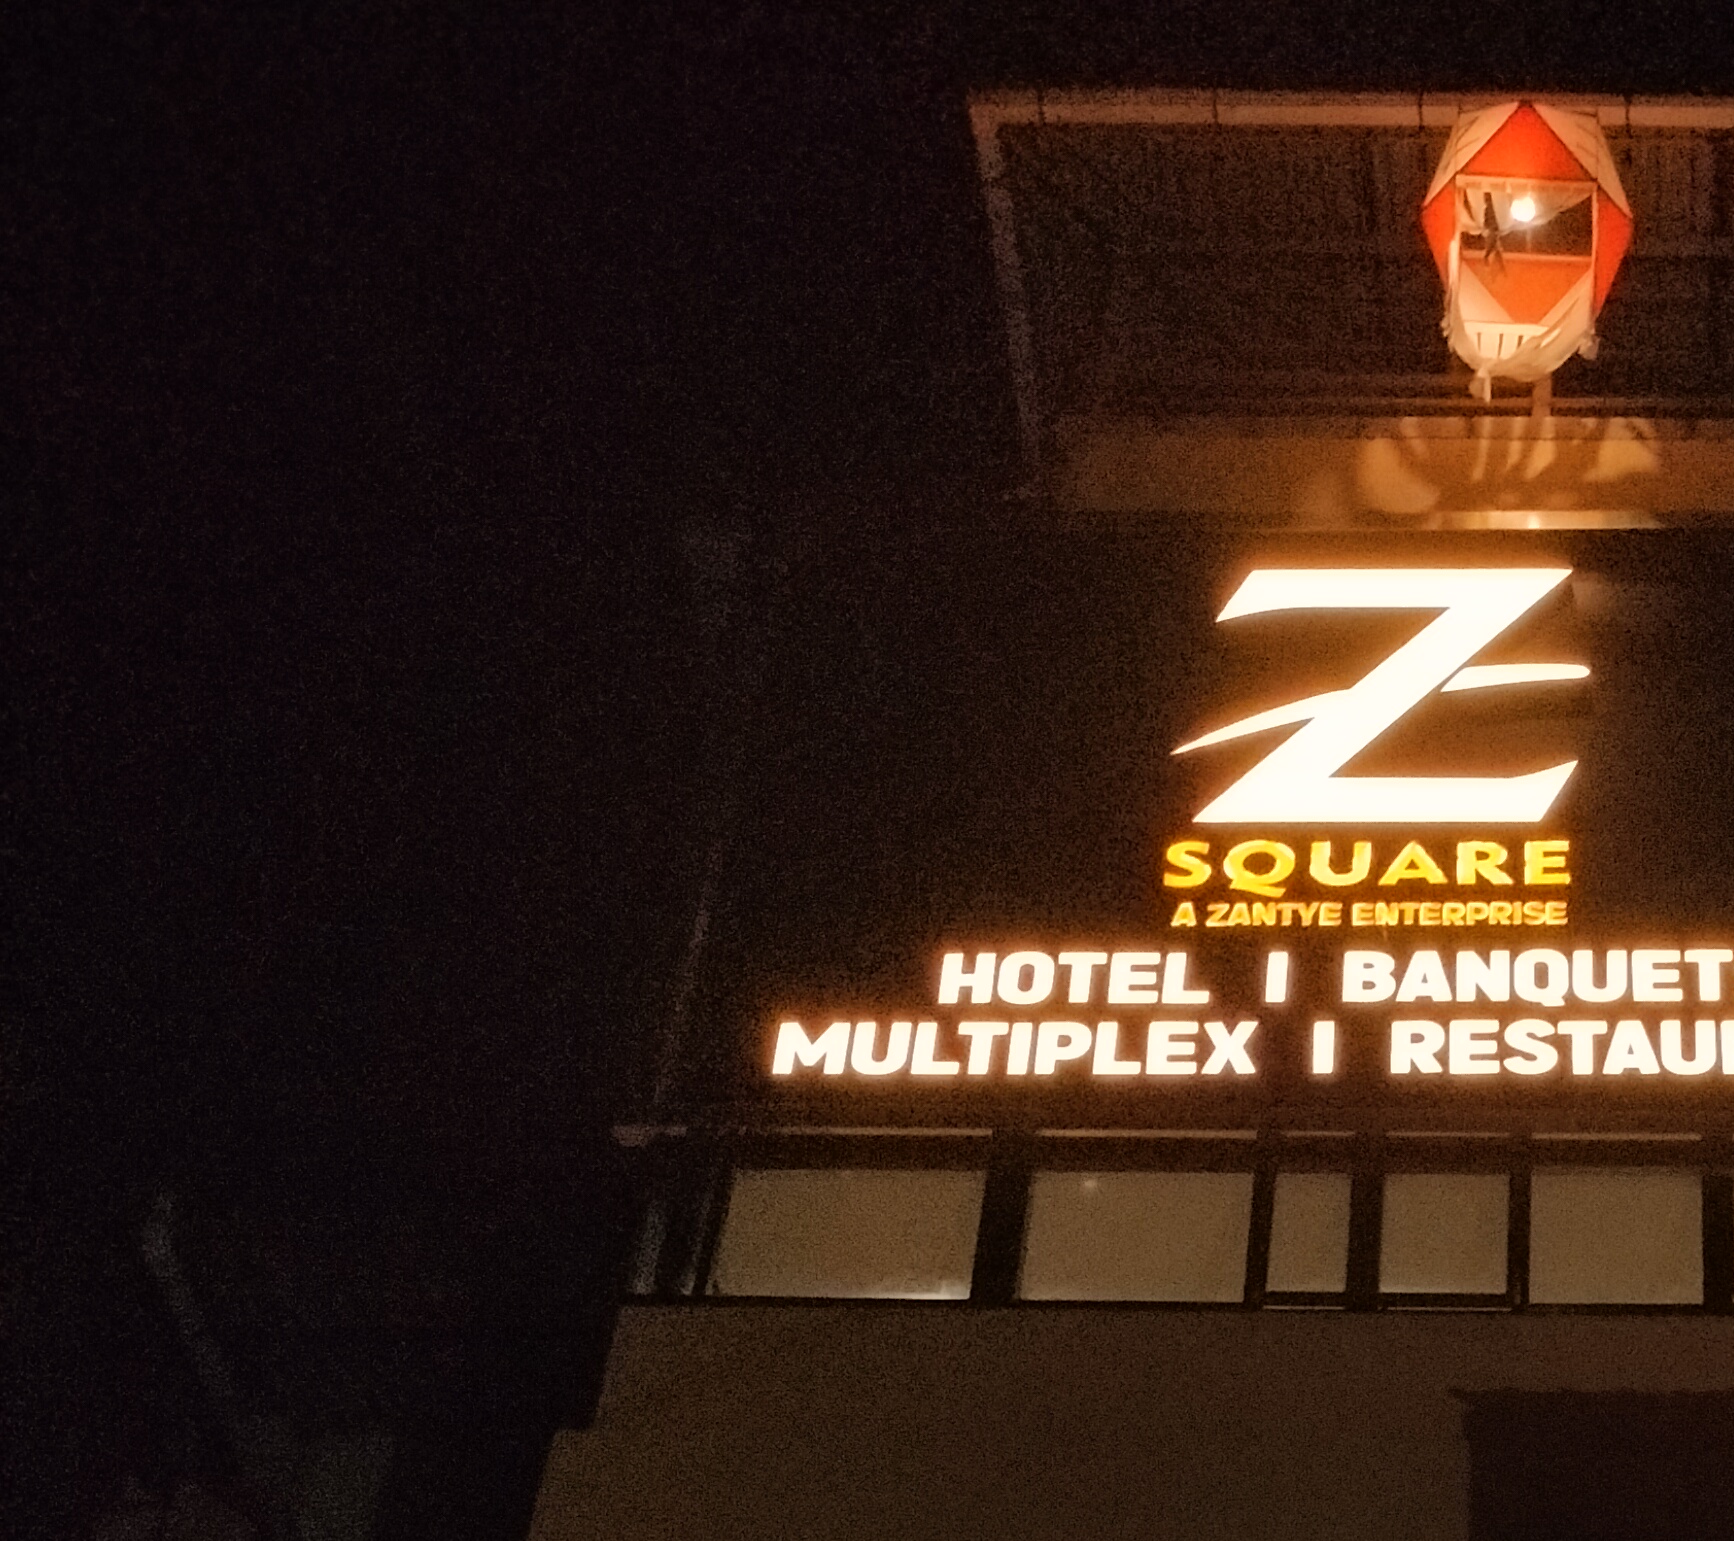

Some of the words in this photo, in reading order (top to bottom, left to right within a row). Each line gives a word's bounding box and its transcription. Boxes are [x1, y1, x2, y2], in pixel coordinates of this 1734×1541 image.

[1171, 567, 1590, 823] Z
[1163, 839, 1572, 898] SQUARE
[1170, 901, 1198, 928] A
[1204, 901, 1343, 928] ZANTYE
[1350, 901, 1569, 928] ENTERPRISE
[937, 950, 1211, 1006] HOTEL
[771, 1020, 1259, 1076] MULTIPLEX
